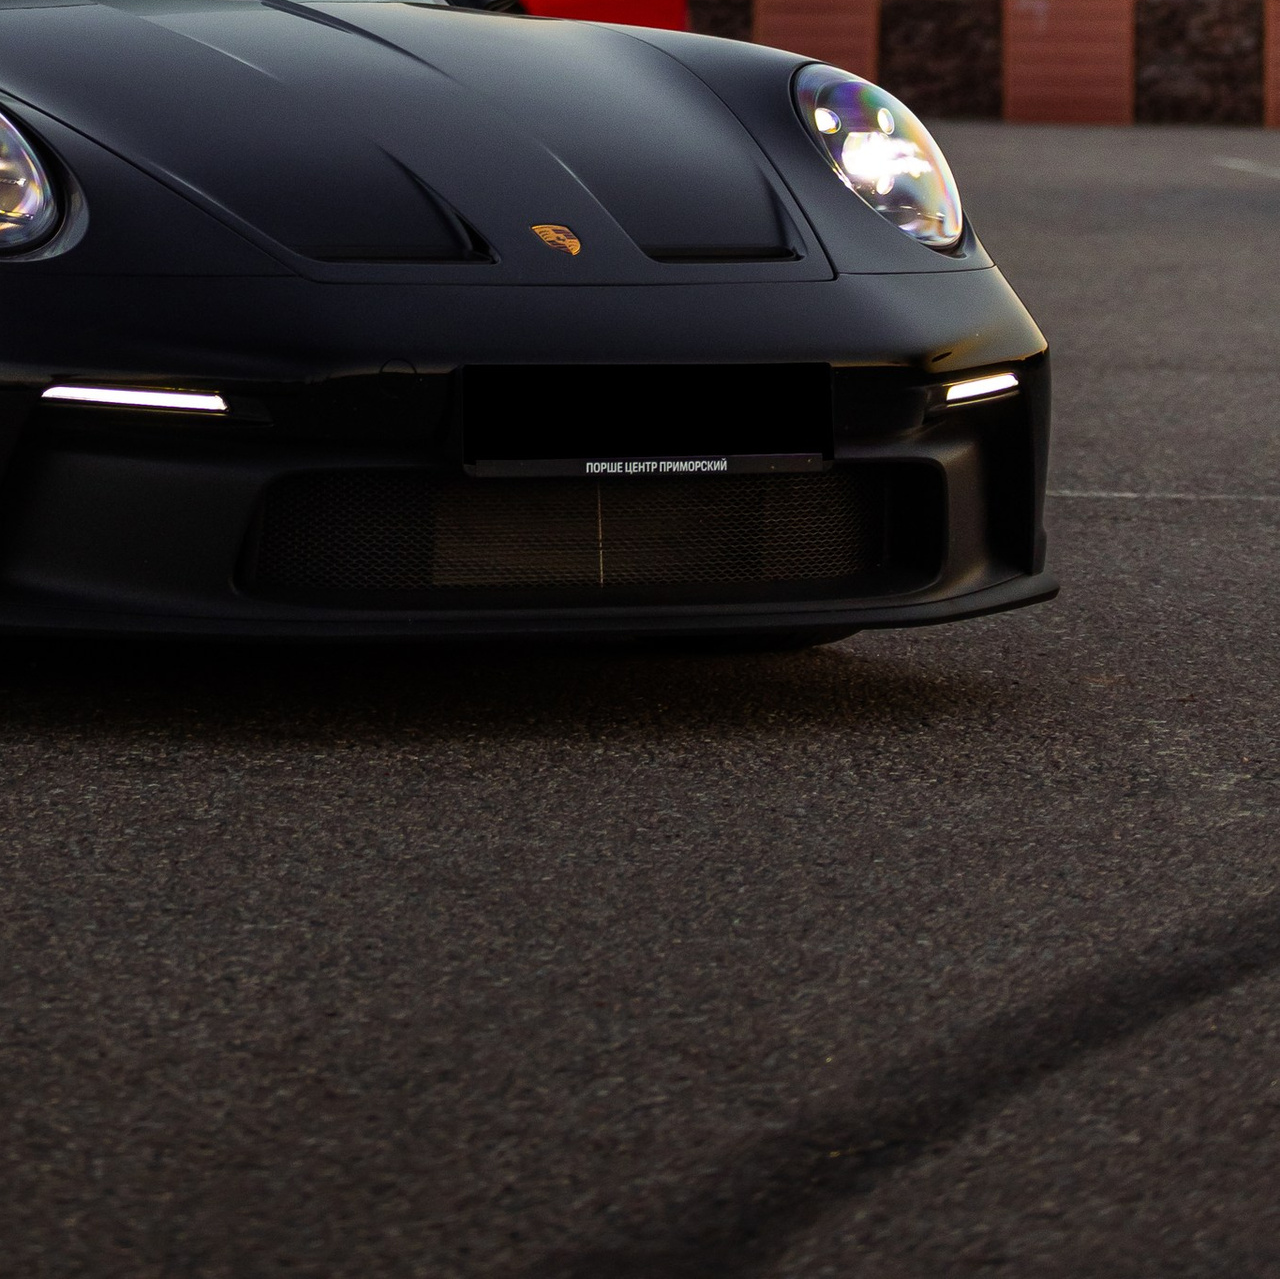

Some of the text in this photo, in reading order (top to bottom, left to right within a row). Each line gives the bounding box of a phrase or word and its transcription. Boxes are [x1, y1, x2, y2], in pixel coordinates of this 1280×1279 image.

[586, 457, 728, 474] ПОРШЕ ЦЕНТР ПРИМОРСКИЙ
